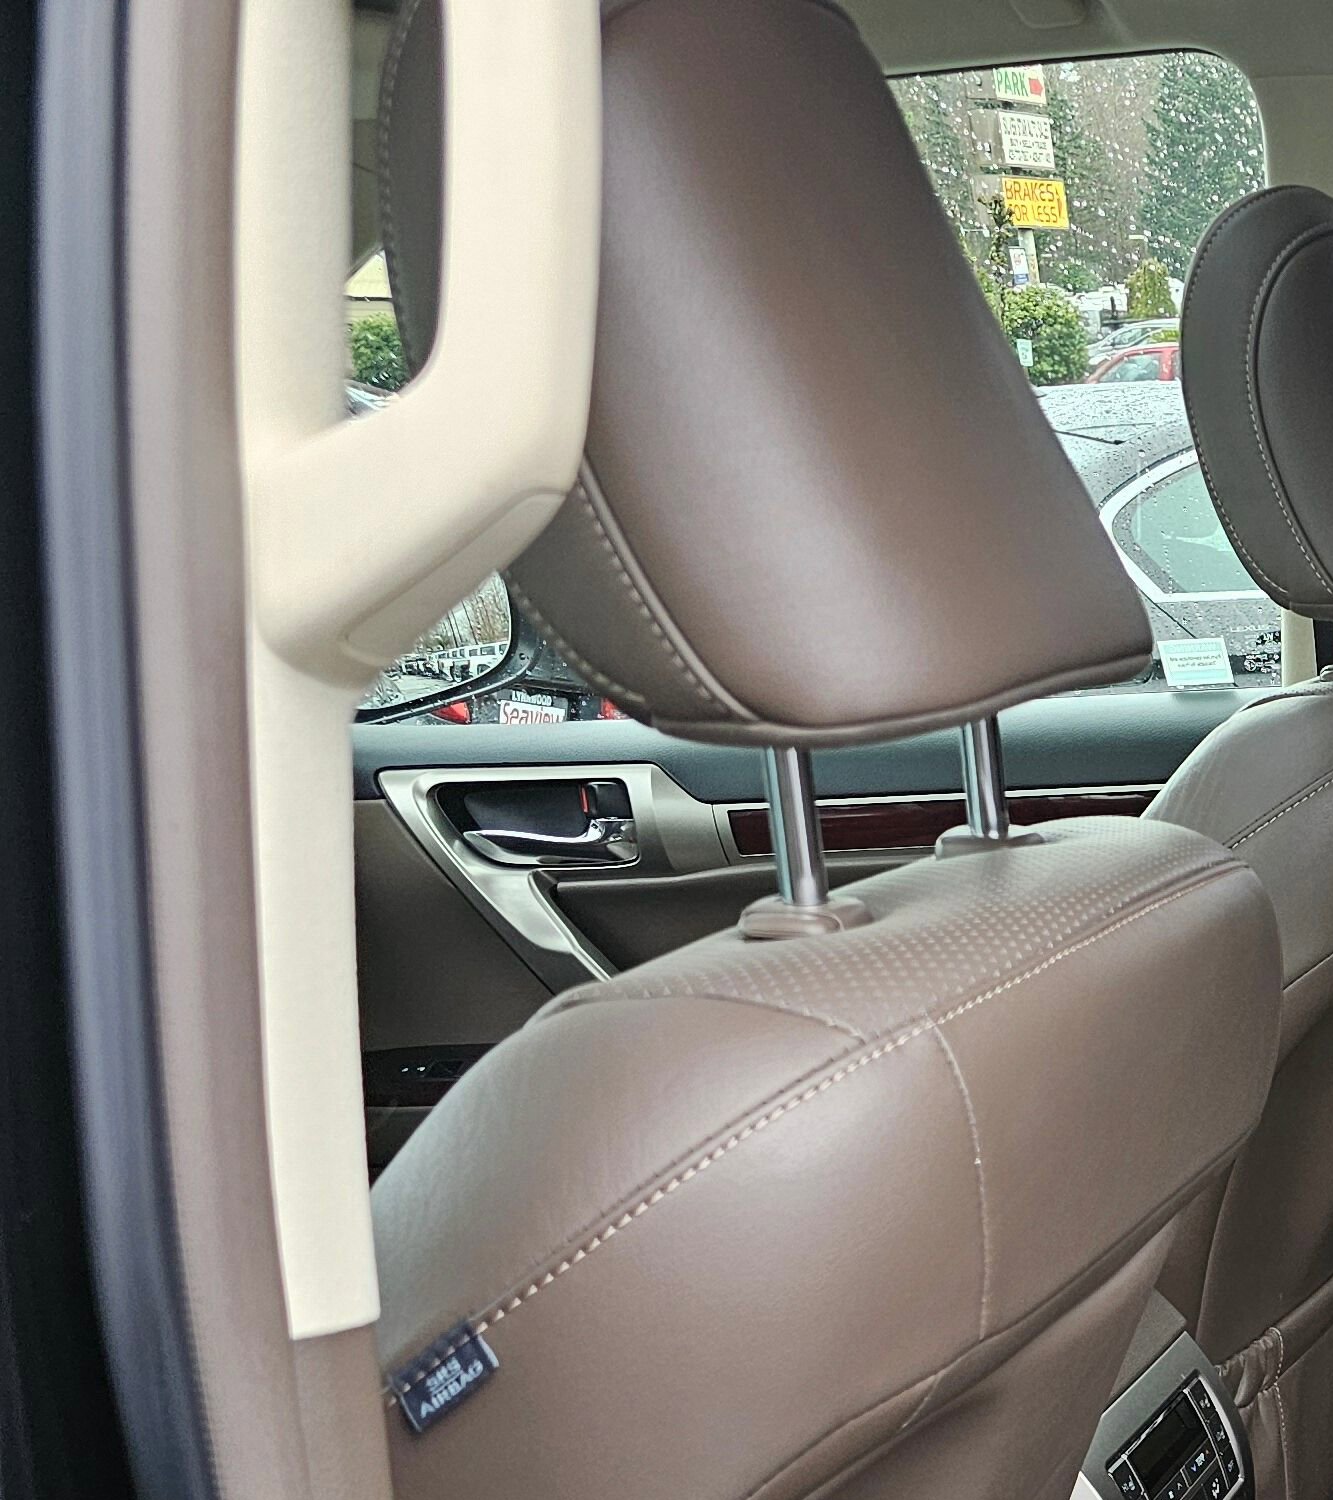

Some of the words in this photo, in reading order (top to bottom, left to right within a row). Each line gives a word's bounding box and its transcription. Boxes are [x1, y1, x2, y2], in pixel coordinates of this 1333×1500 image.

[996, 71, 1028, 97] PARK
[1005, 181, 1055, 202] BRAKES
[1032, 205, 1058, 223] LESS
[420, 1359, 484, 1419] AIRBAG
